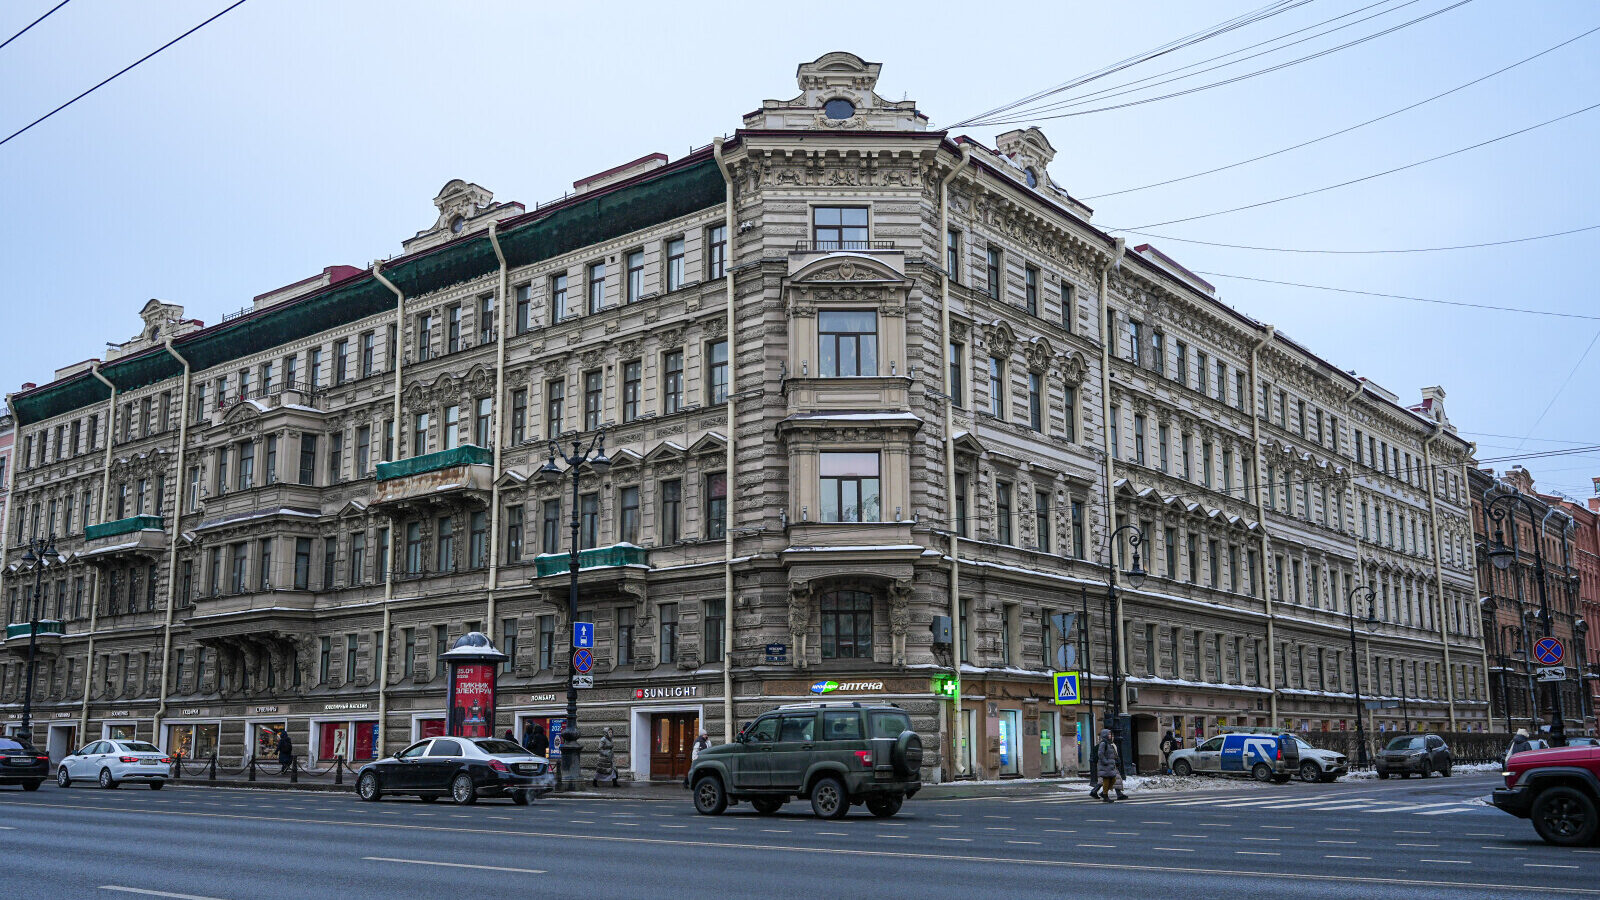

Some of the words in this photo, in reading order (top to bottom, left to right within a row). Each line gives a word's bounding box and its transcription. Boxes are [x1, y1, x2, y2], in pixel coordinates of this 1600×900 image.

[839, 682, 883, 691] аптека
[644, 686, 697, 698] SUNLIGHT
[530, 694, 556, 702] ЛОМБАРД
